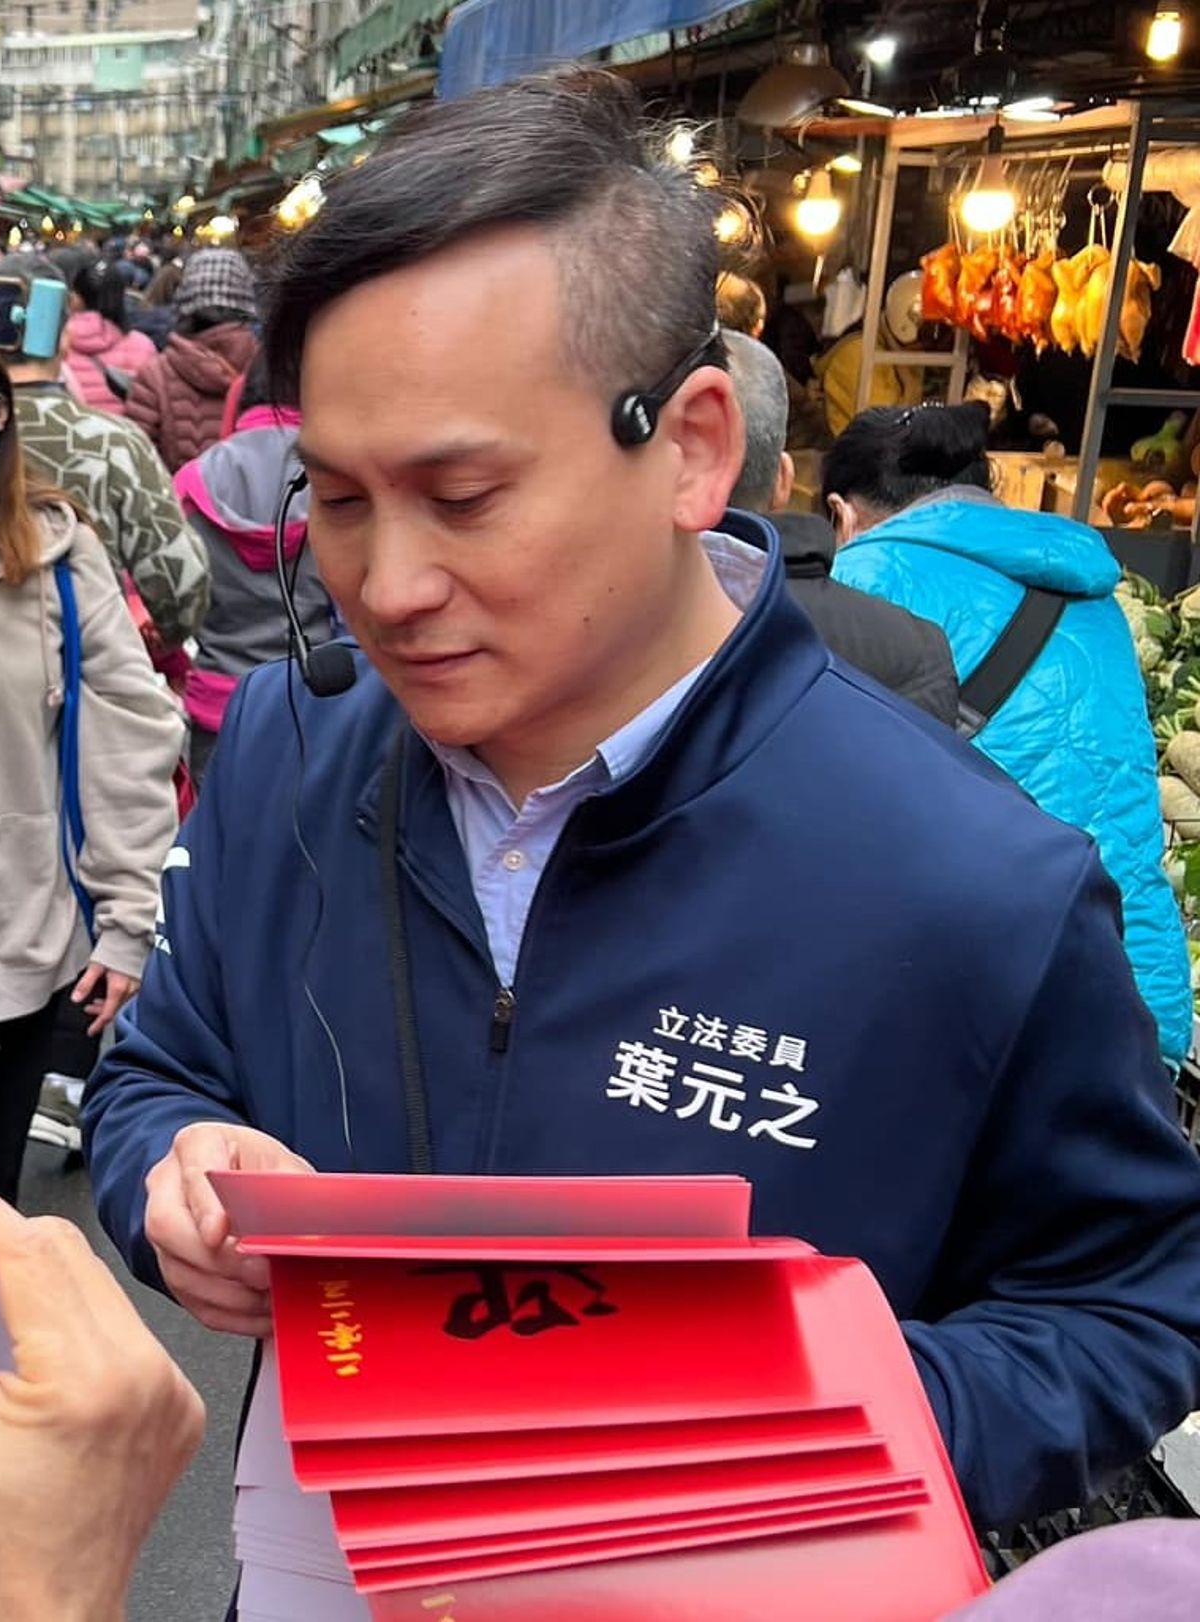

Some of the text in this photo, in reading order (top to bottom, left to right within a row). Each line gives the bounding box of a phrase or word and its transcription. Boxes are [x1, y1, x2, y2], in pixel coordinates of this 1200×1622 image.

[653, 1006, 807, 1072] 立法委員
[605, 1041, 820, 1149] 葉元之
